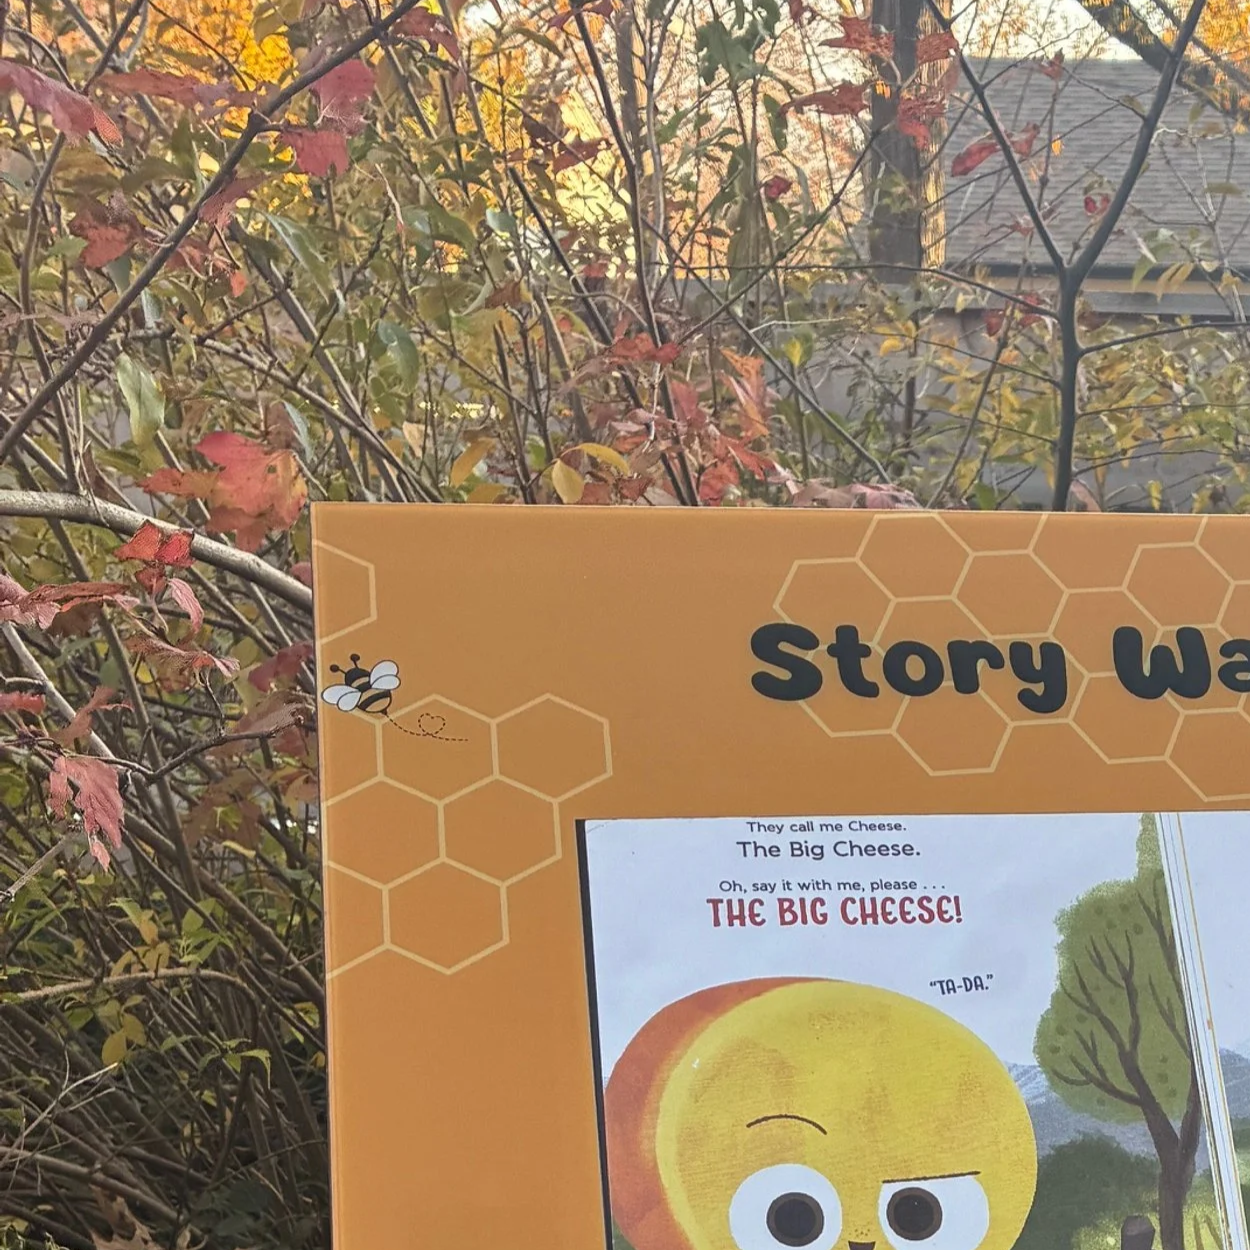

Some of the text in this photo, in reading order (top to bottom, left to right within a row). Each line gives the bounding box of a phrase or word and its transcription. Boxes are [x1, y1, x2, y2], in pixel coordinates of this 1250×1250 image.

[750, 622, 1069, 714] Story
[746, 820, 907, 834] They call me Cheese.
[736, 840, 921, 860] The Big Cheese.
[719, 879, 748, 894] Oh,
[752, 882, 777, 894] say
[782, 879, 793, 891] it
[797, 879, 832, 891] with
[837, 881, 865, 893] me,
[706, 895, 963, 927] THE BIG CHEESE!
